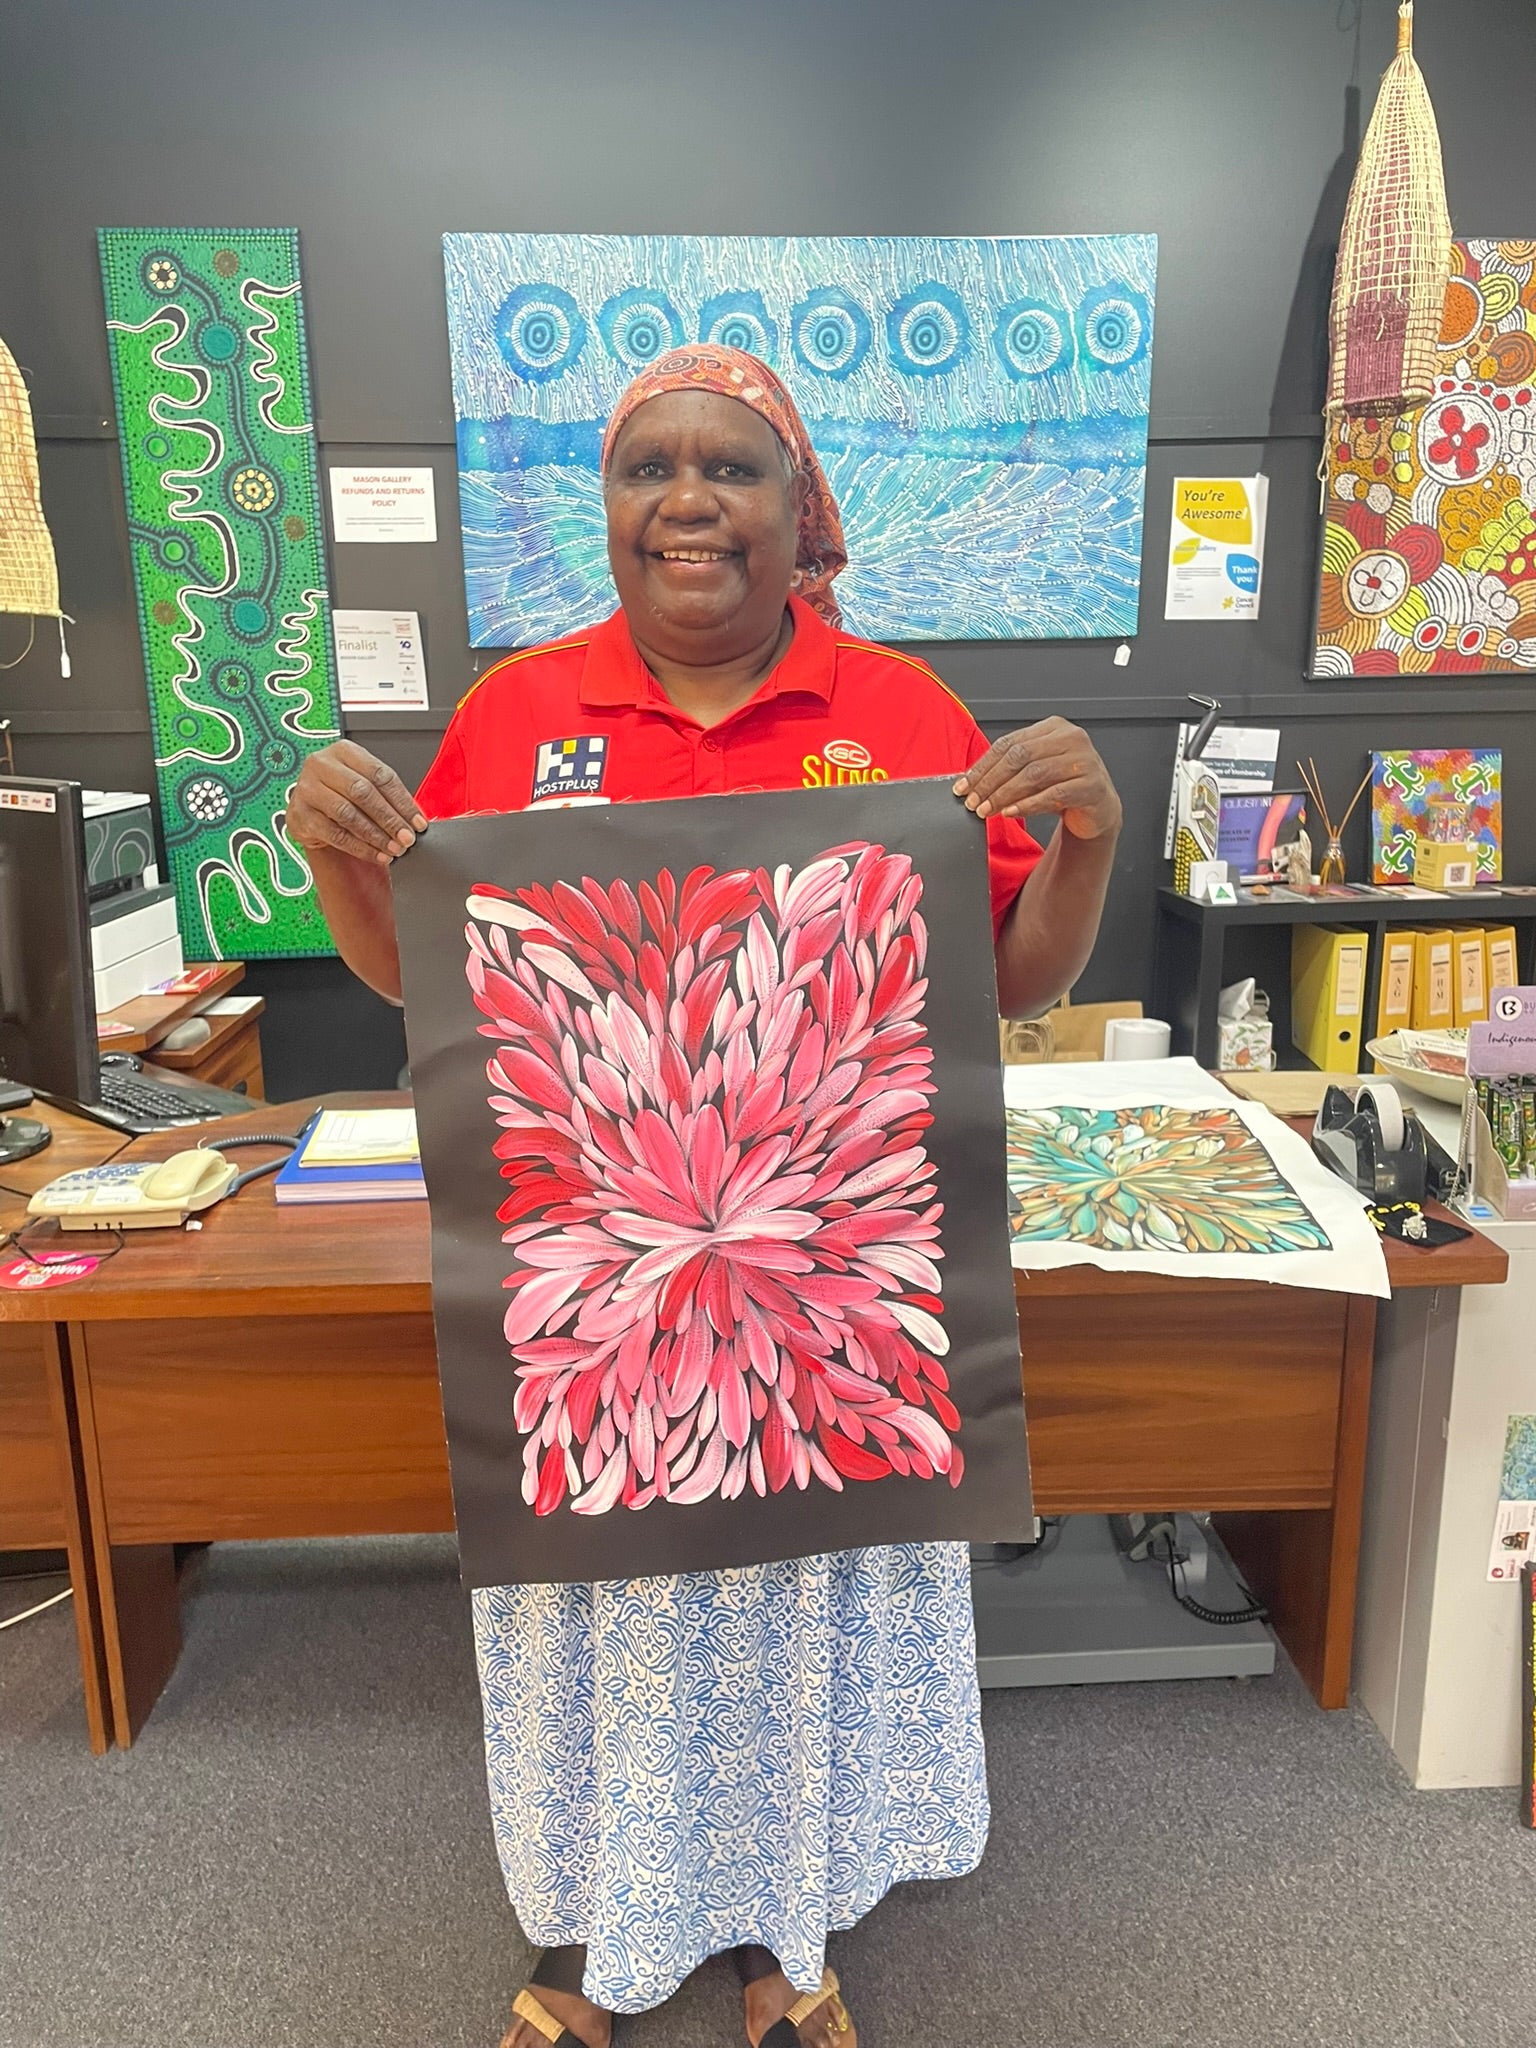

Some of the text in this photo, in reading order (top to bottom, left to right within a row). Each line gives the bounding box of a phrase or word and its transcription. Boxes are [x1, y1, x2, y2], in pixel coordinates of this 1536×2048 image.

[1231, 565, 1258, 574] Thank
[338, 639, 378, 651] Finalist
[533, 779, 599, 799] HOSTPLUS
